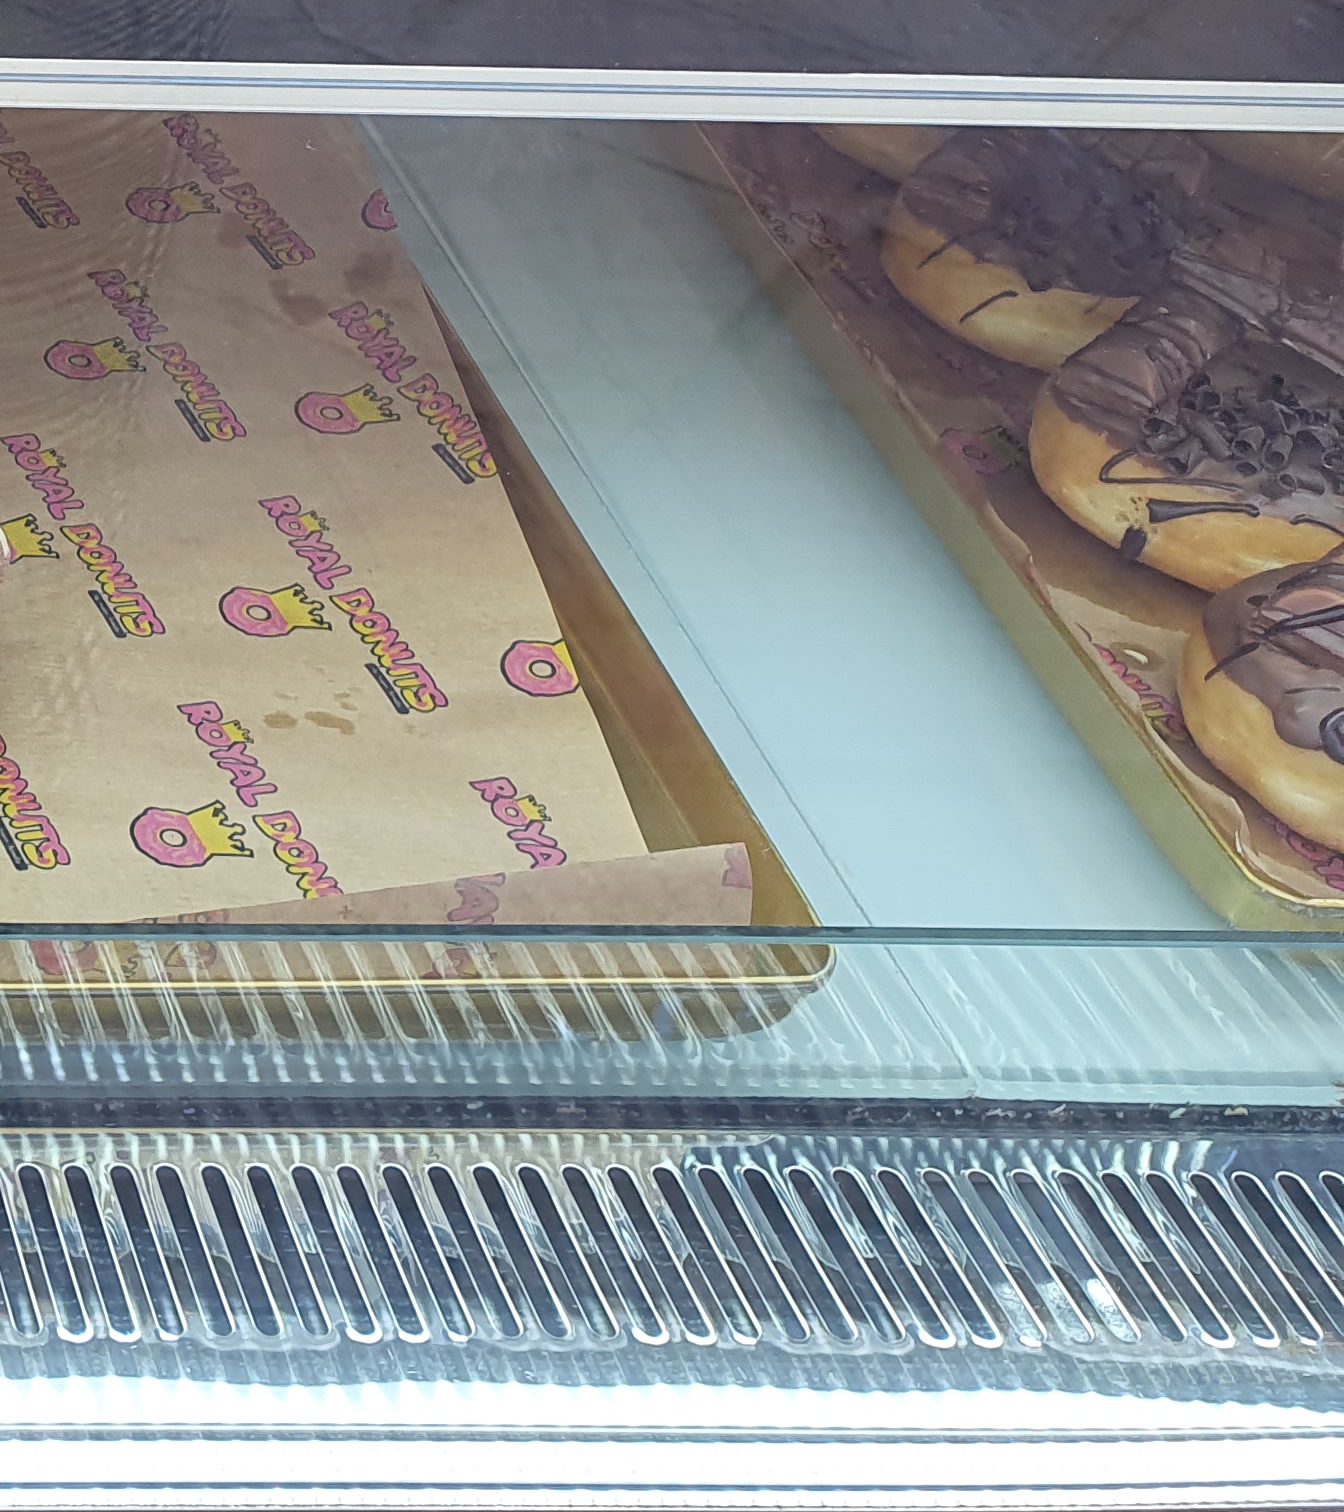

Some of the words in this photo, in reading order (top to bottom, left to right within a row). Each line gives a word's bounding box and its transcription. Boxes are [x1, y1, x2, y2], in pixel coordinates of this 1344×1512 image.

[219, 183, 316, 266] DONUTS
[88, 270, 167, 342] ROYAL
[146, 342, 247, 441] DONUTS
[328, 301, 417, 384] ROYAL
[397, 373, 498, 478] DONUTS
[0, 433, 84, 521] ROYAL
[60, 523, 166, 638] DONUTS
[258, 495, 352, 589] ROYAL
[329, 588, 449, 713] DONUTS
[176, 701, 278, 807] ROYAL
[468, 776, 568, 869] ROYA
